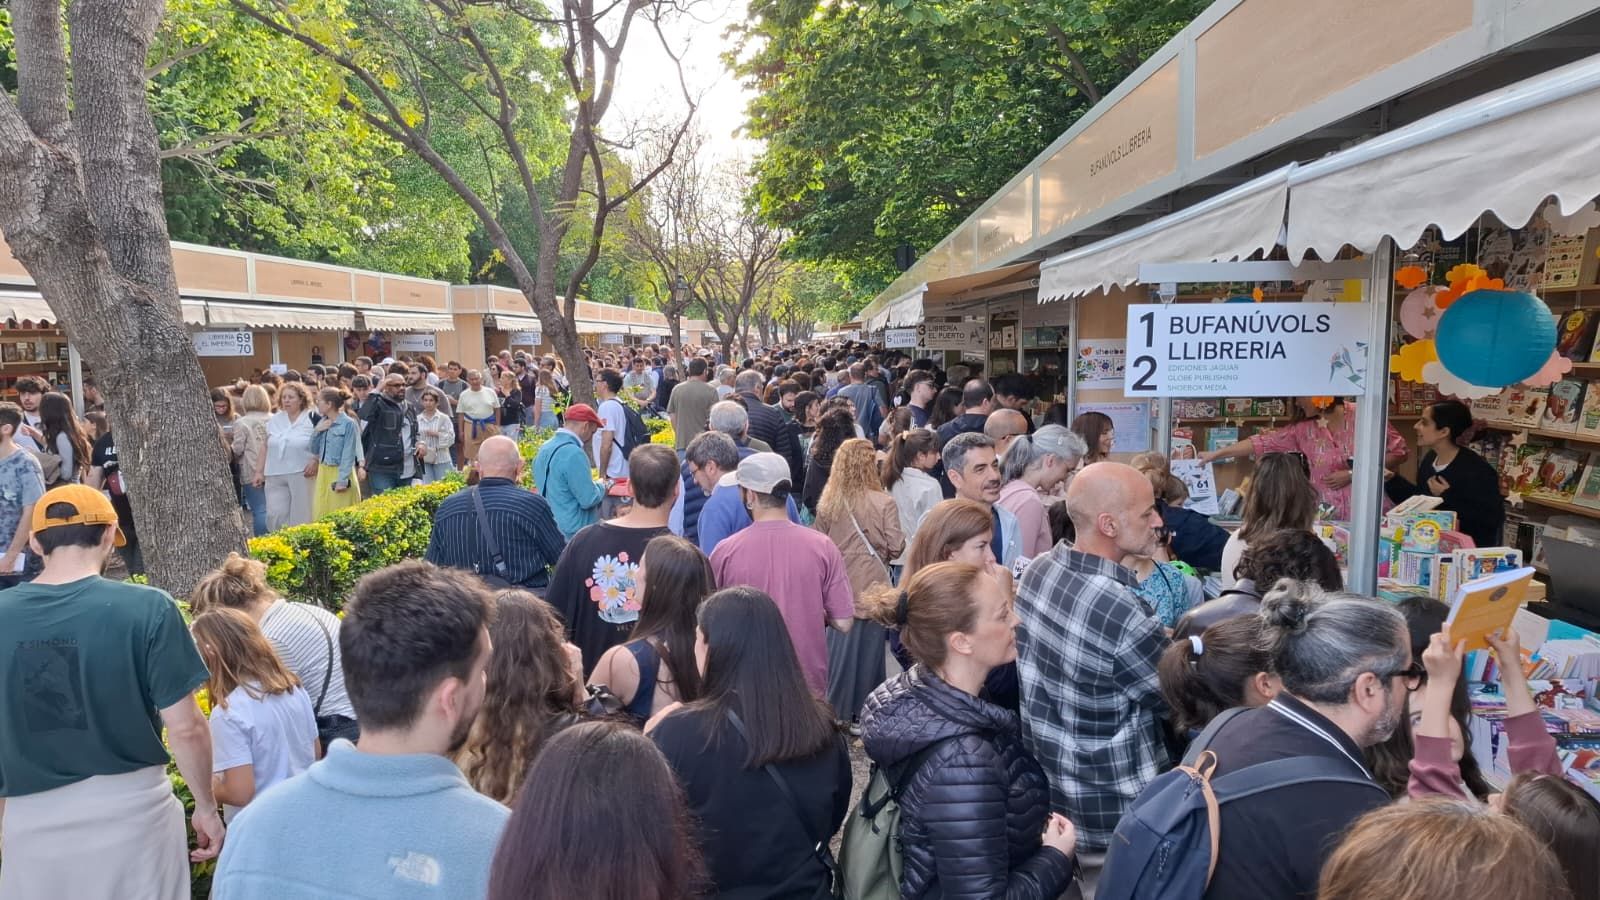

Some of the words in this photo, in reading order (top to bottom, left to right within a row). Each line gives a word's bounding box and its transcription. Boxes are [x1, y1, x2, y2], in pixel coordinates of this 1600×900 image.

[1121, 126, 1152, 157] LLIBRERIA
[1169, 309, 1331, 334] BUFANÚVOLS
[918, 324, 926, 336] 3
[1139, 311, 1155, 348] 1
[237, 332, 251, 343] 69
[918, 337, 926, 348] 4
[237, 343, 251, 354] 70
[1168, 341, 1287, 361] LLIBRERIA
[1131, 355, 1158, 391] 2
[1168, 384, 1203, 392] SHOEBOX
[1196, 480, 1209, 489] 61
